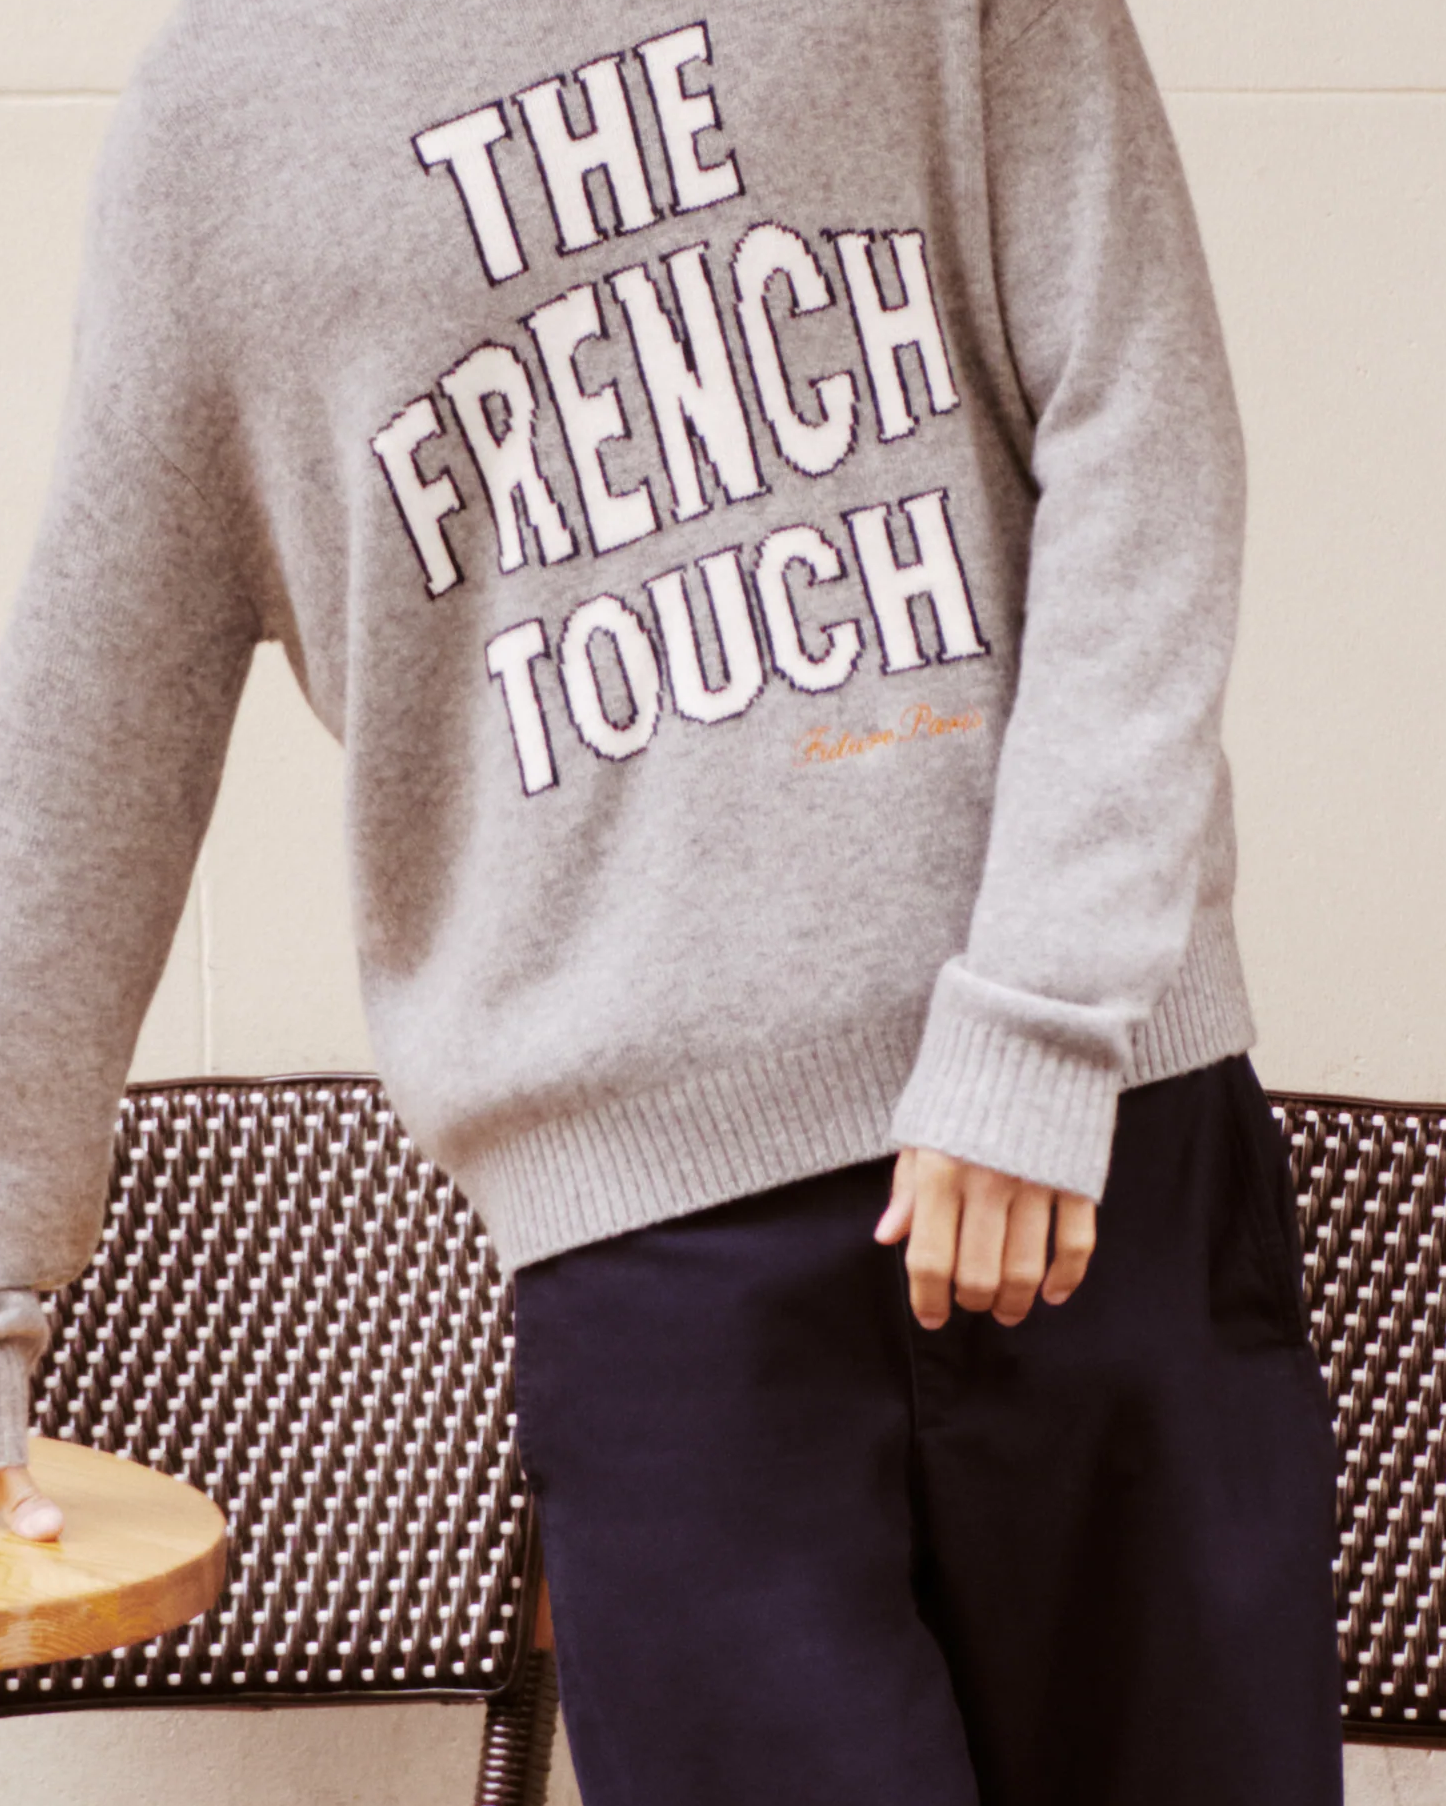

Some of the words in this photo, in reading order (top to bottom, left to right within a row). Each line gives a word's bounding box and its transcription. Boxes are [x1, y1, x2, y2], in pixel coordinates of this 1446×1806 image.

[410, 19, 746, 287] THE
[370, 219, 961, 602] FRENCH
[484, 487, 990, 798] TOUCH
